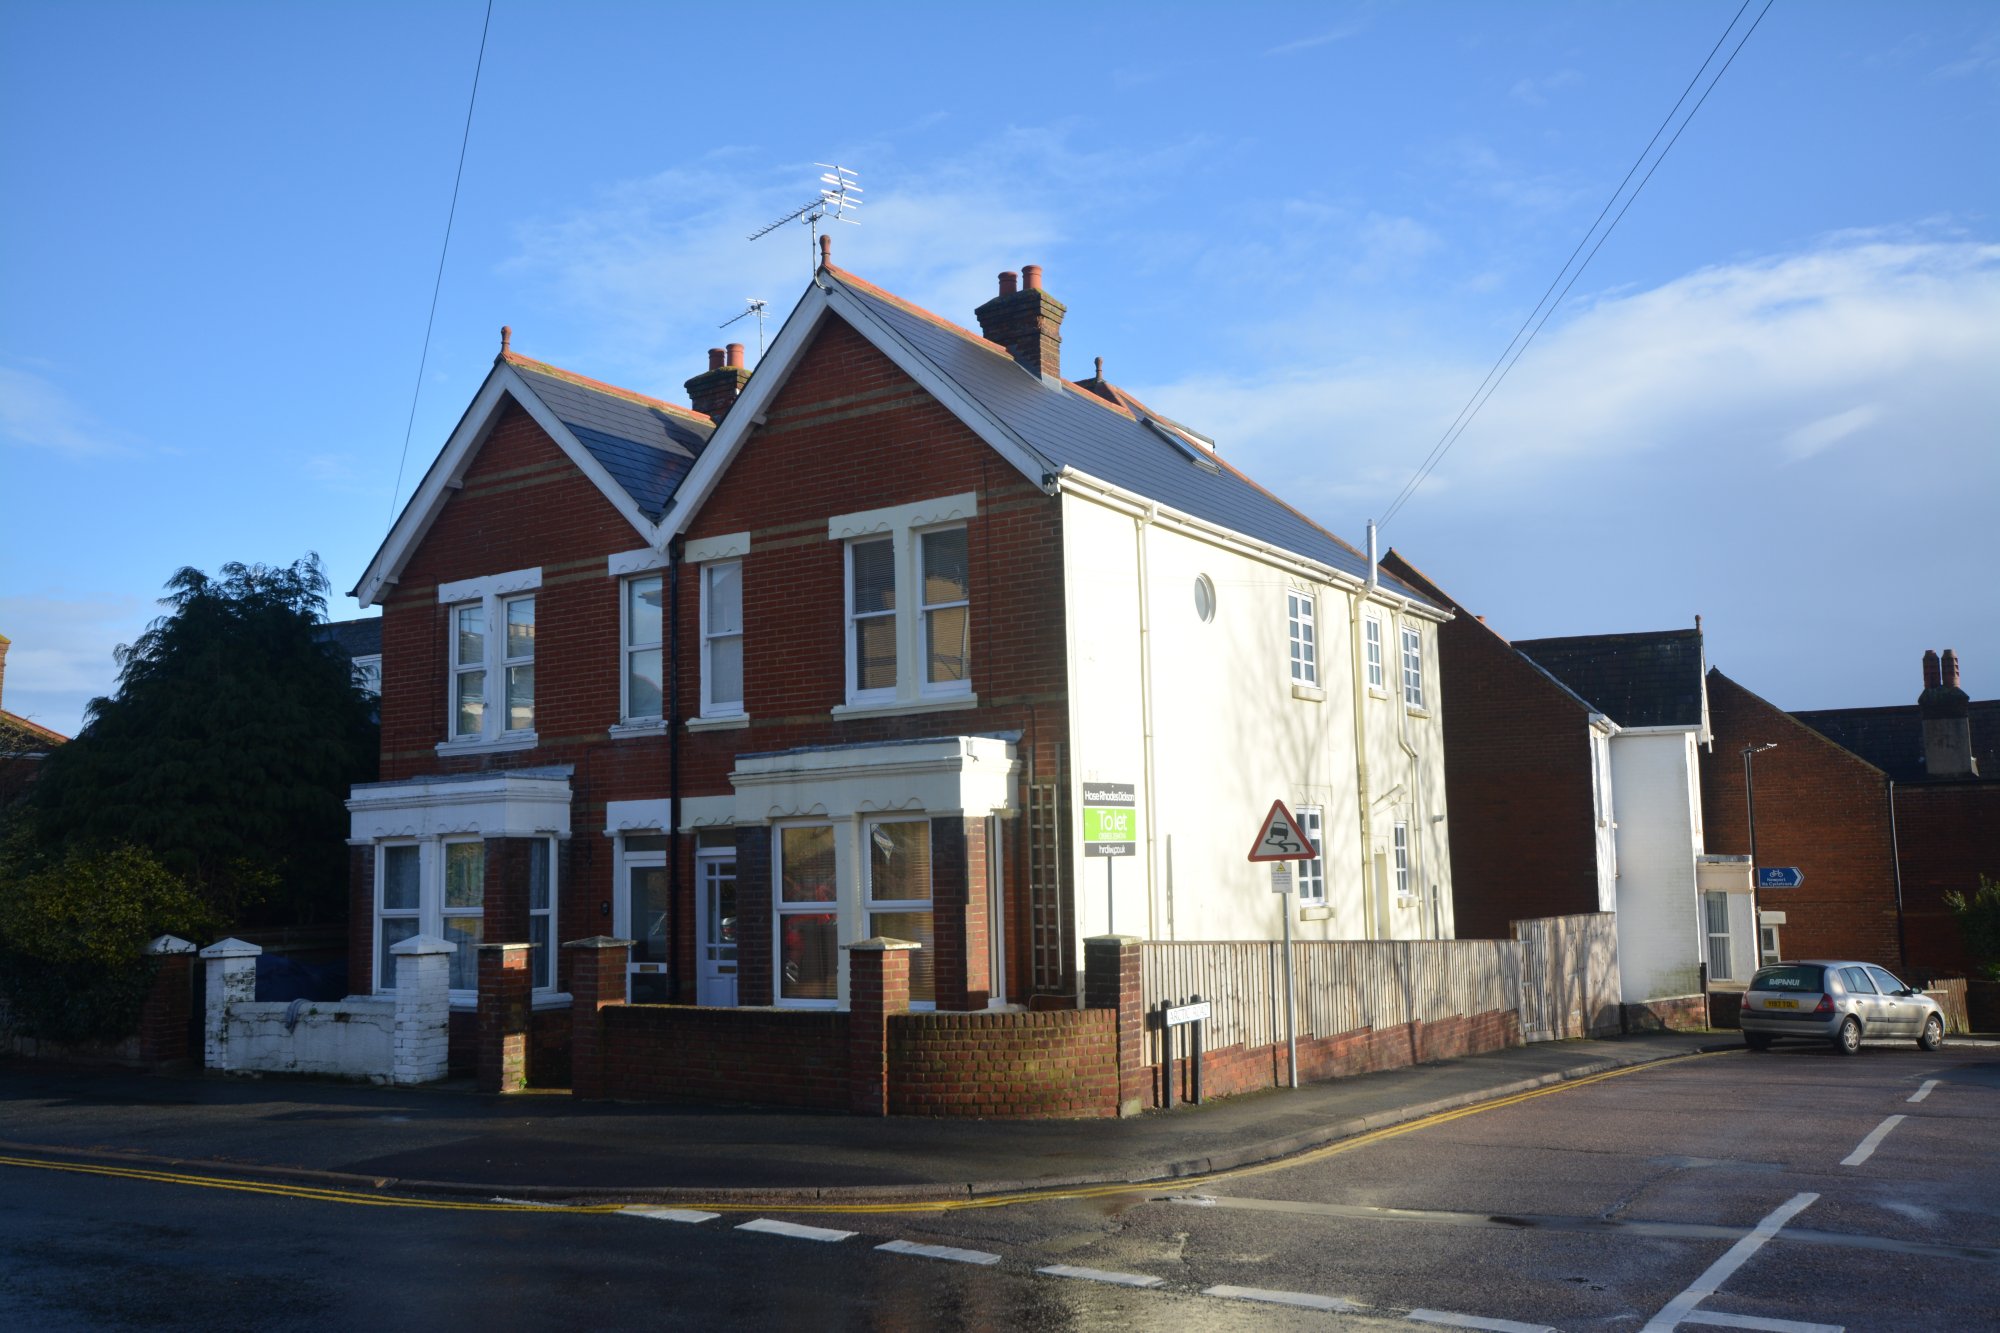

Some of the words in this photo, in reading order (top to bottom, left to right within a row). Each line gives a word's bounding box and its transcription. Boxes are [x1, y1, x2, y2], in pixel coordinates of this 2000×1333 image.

[1085, 790, 1099, 801] Hose
[1099, 791, 1118, 801] Rhodes
[1097, 810, 1113, 831] To
[1114, 810, 1128, 831] let
